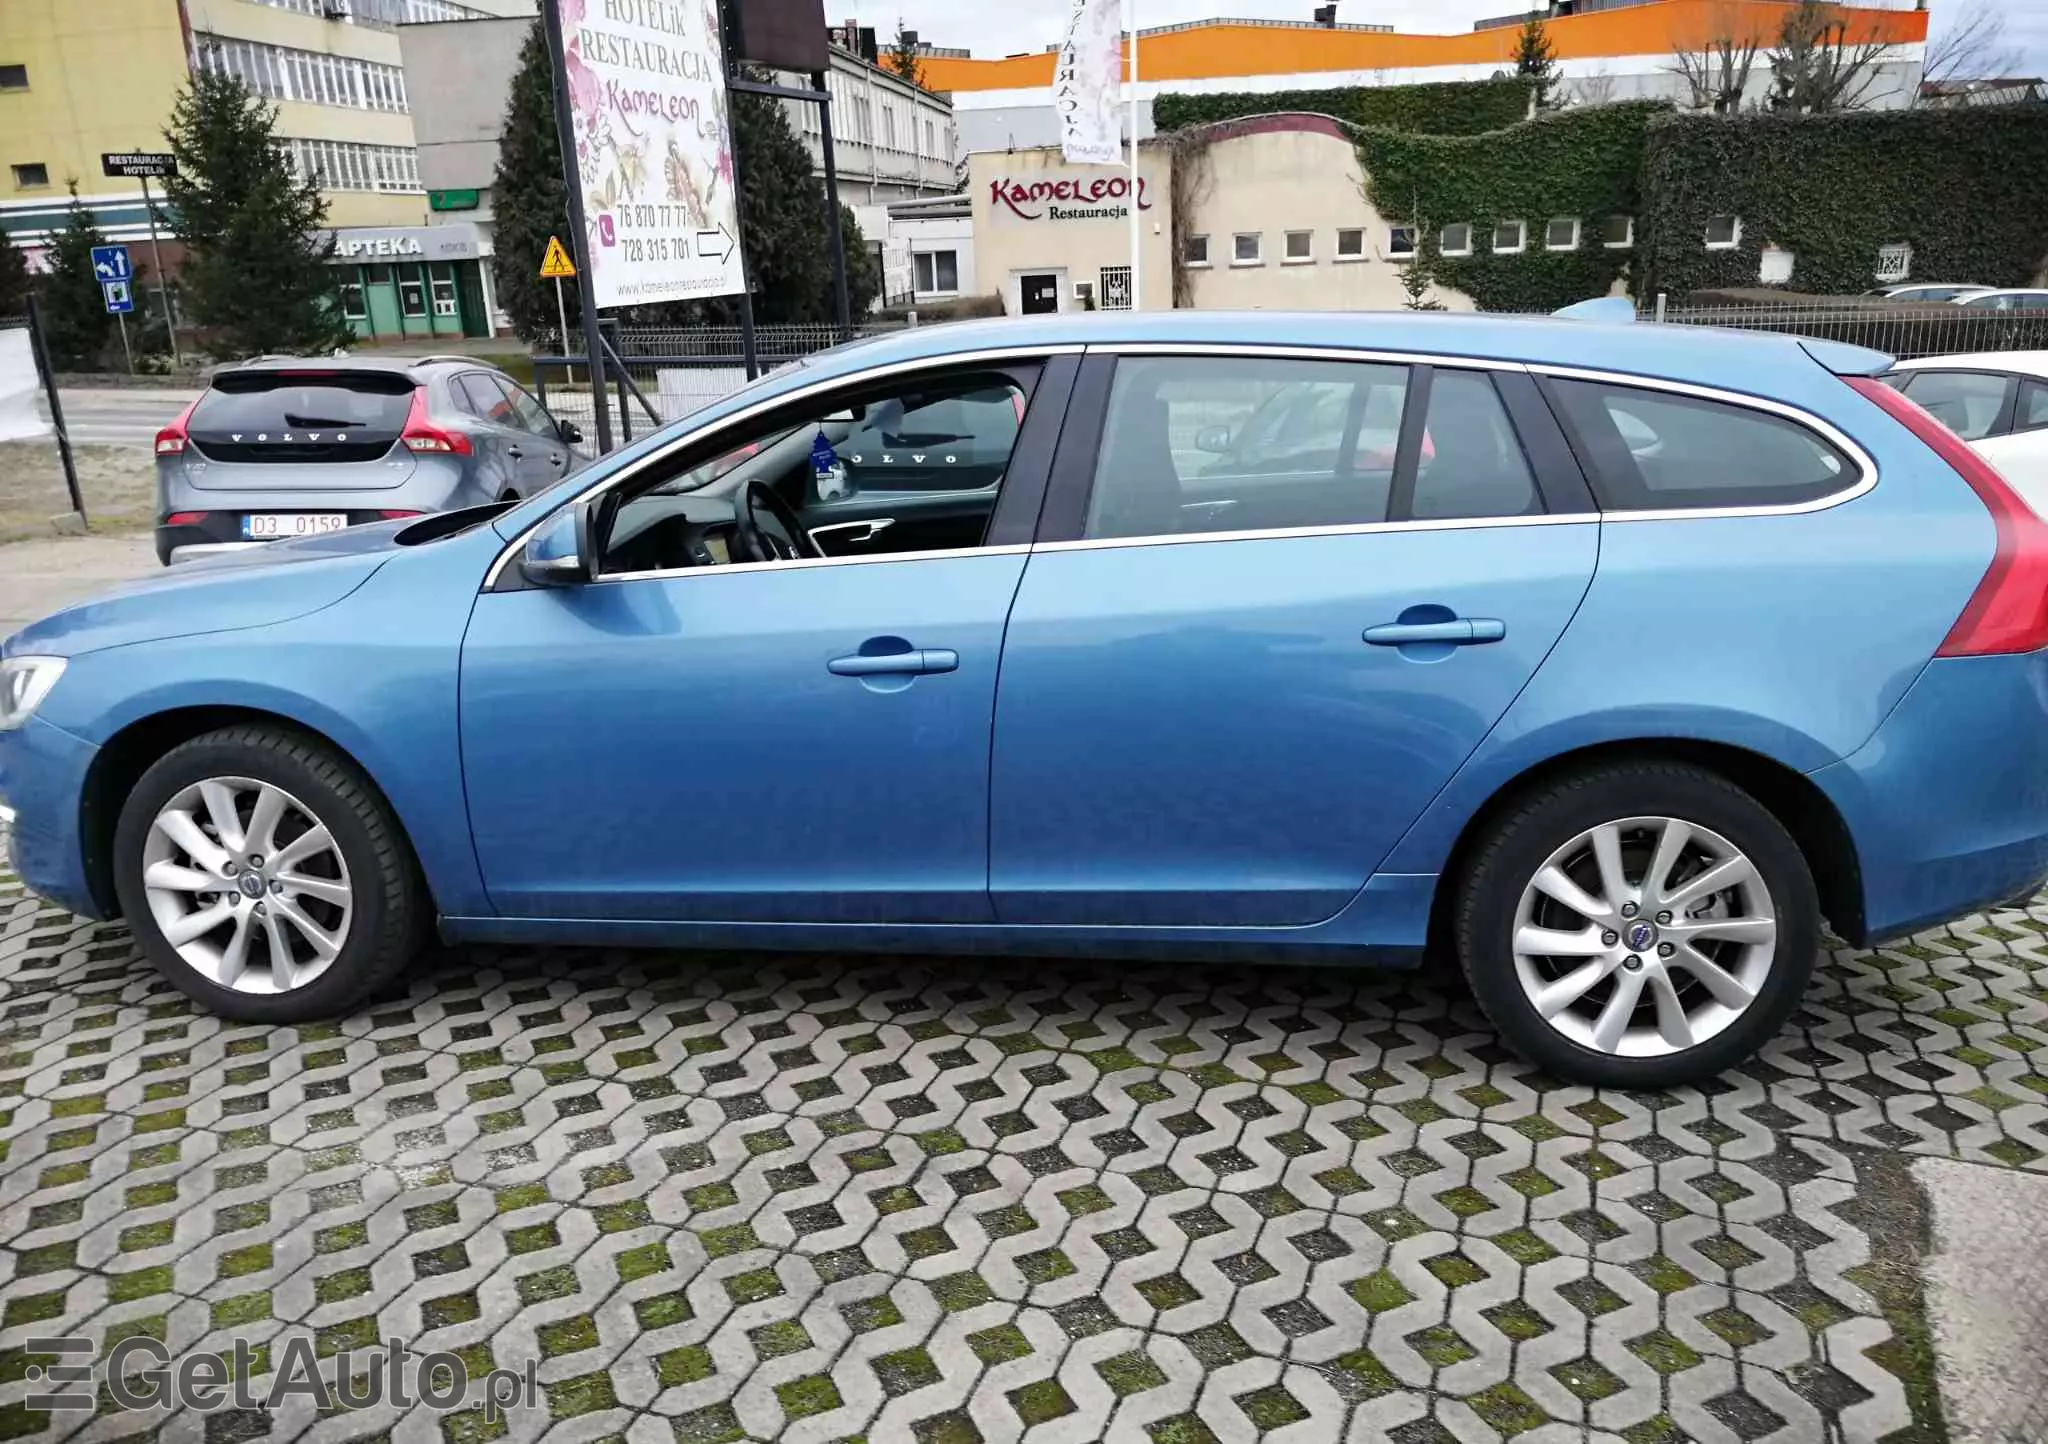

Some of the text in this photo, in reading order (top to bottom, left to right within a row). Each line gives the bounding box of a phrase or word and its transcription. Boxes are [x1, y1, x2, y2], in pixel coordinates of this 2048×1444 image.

[580, 29, 712, 82] RESTAURACJA
[617, 204, 687, 229] 76 870 77 77
[1049, 205, 1128, 220] Restauracja
[334, 238, 424, 256] APTEKA
[621, 238, 690, 262] 728 315 701
[231, 433, 347, 442] VOLVO
[851, 454, 957, 464] OLVO
[254, 516, 277, 535] D3
